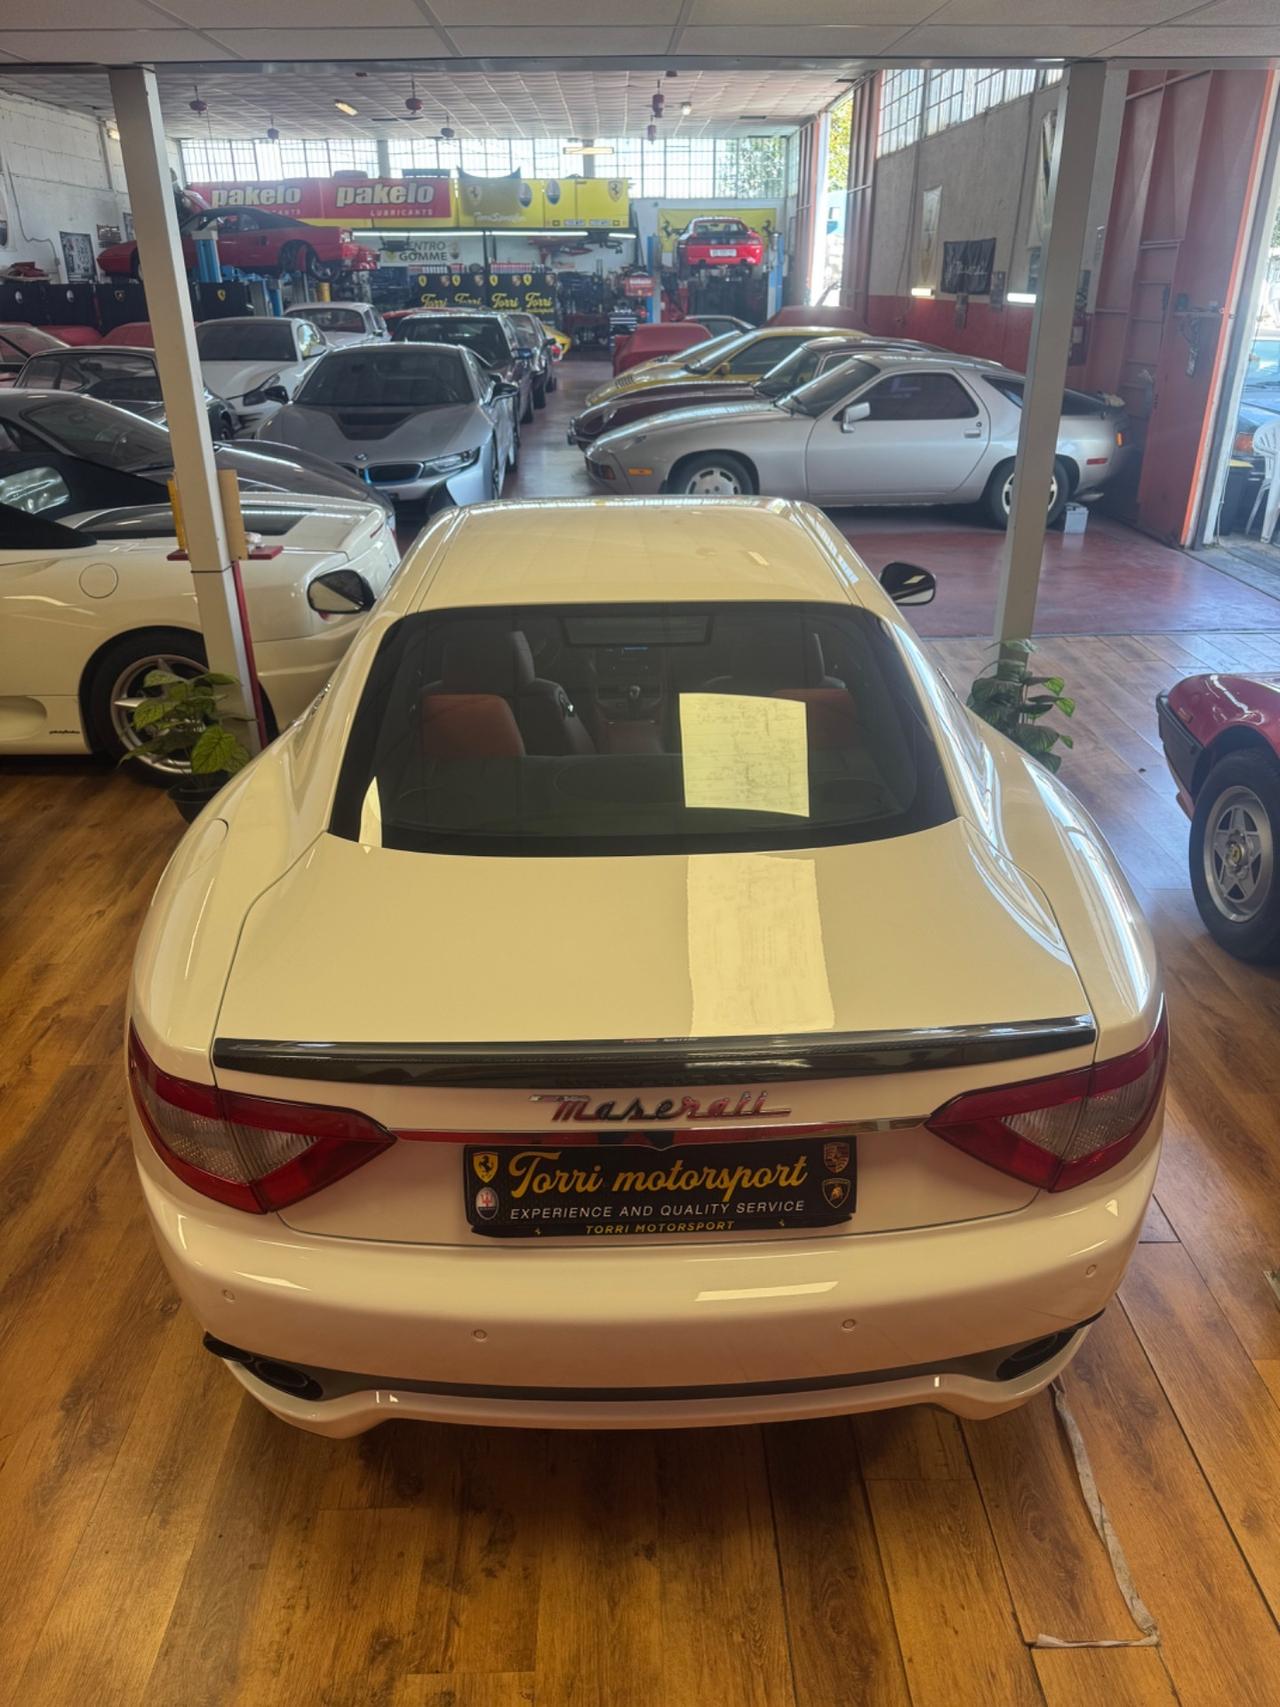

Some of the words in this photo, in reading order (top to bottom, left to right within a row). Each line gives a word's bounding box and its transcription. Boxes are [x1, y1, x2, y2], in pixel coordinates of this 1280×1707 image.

[211, 184, 302, 208] pakelo
[336, 182, 434, 207] pakelo
[370, 208, 433, 216] LUBRICANTS
[408, 240, 446, 251] NTRO
[399, 252, 448, 261] GOMME
[491, 292, 519, 308] Torri
[524, 292, 552, 308] Torri
[527, 1090, 792, 1122] Maserati
[508, 1151, 603, 1198] Torri
[611, 1156, 808, 1201] motorsport
[510, 1206, 612, 1220] EXPERIENCE
[619, 1205, 654, 1217] AND
[661, 1203, 729, 1216] QUALITY
[736, 1200, 805, 1214] SERVICE
[585, 1224, 631, 1235] TORRI
[635, 1220, 735, 1233] MOTORSPORT
